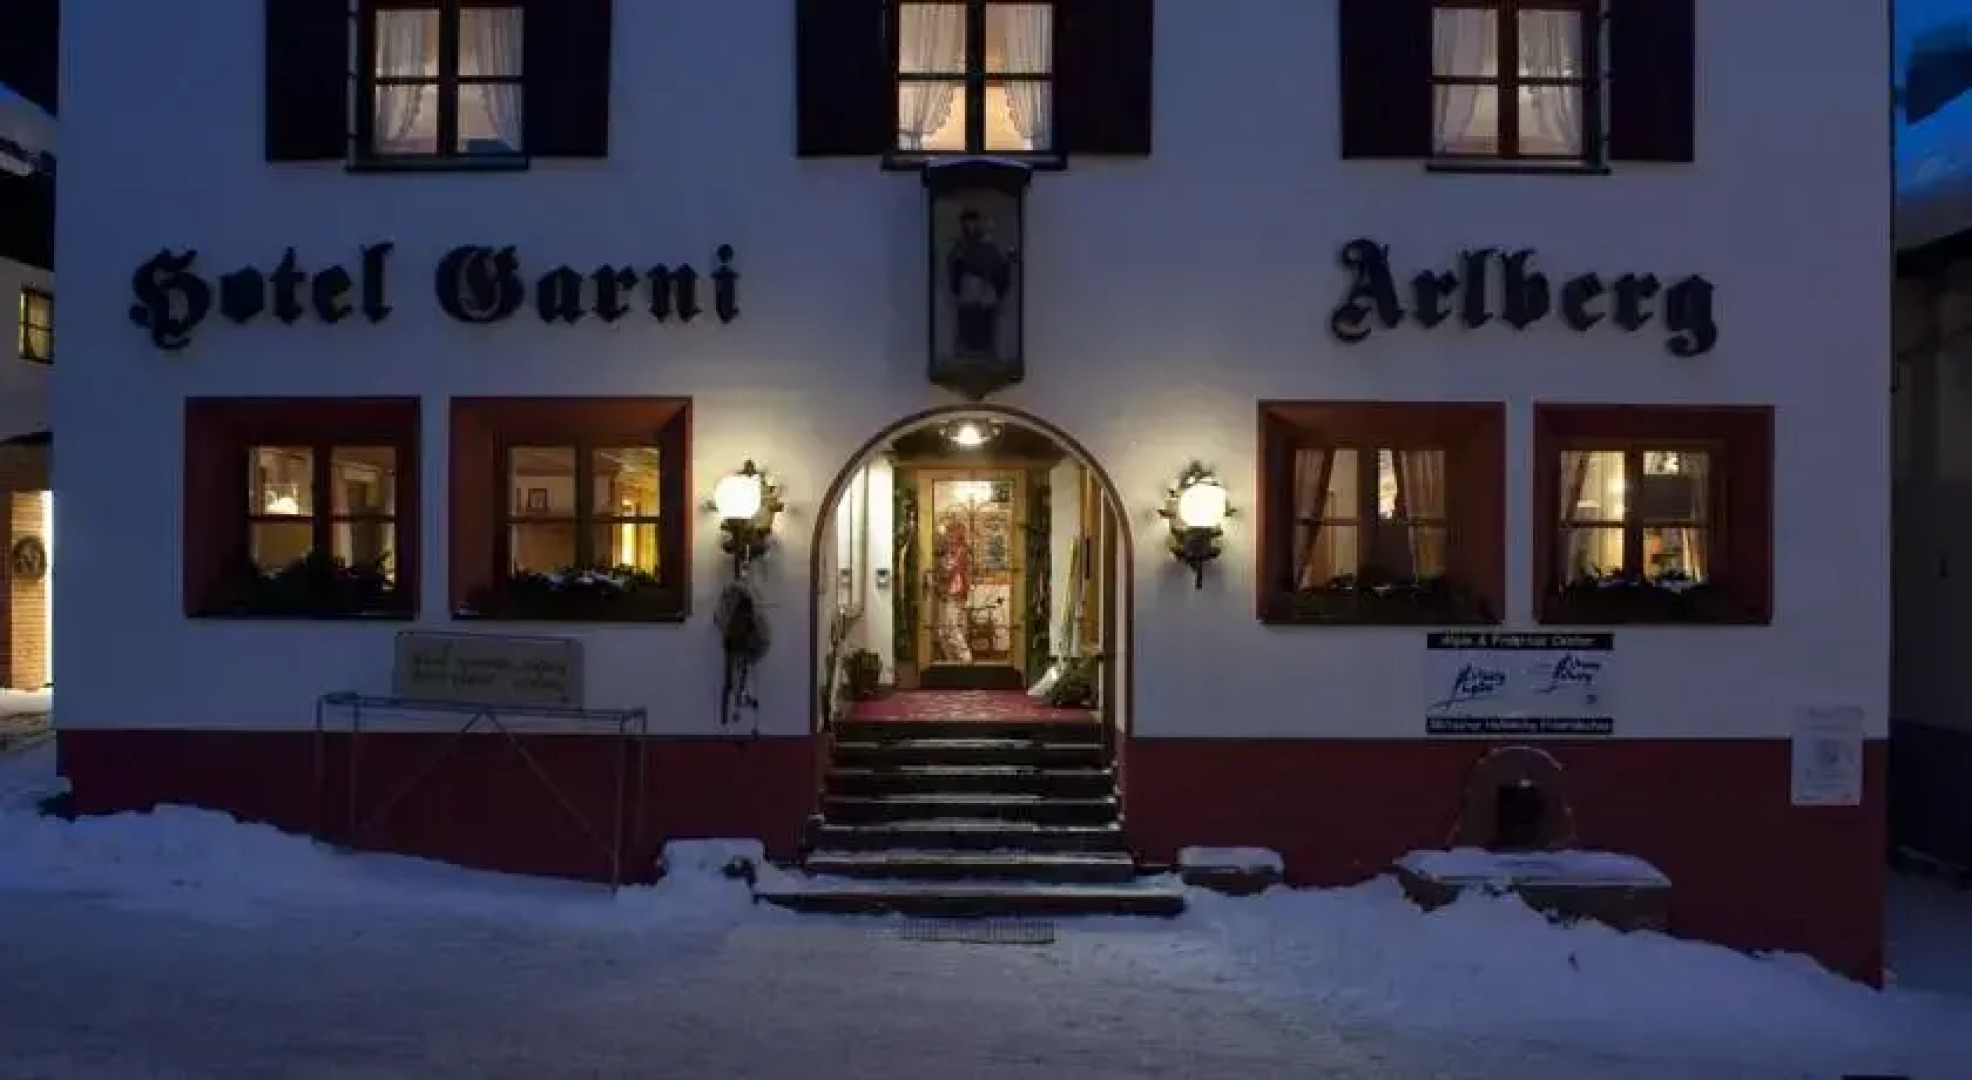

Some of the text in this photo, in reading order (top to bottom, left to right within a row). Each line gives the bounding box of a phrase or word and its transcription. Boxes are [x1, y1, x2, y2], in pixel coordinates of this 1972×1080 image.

[130, 238, 1718, 357] Hotel Garni Arlberg
